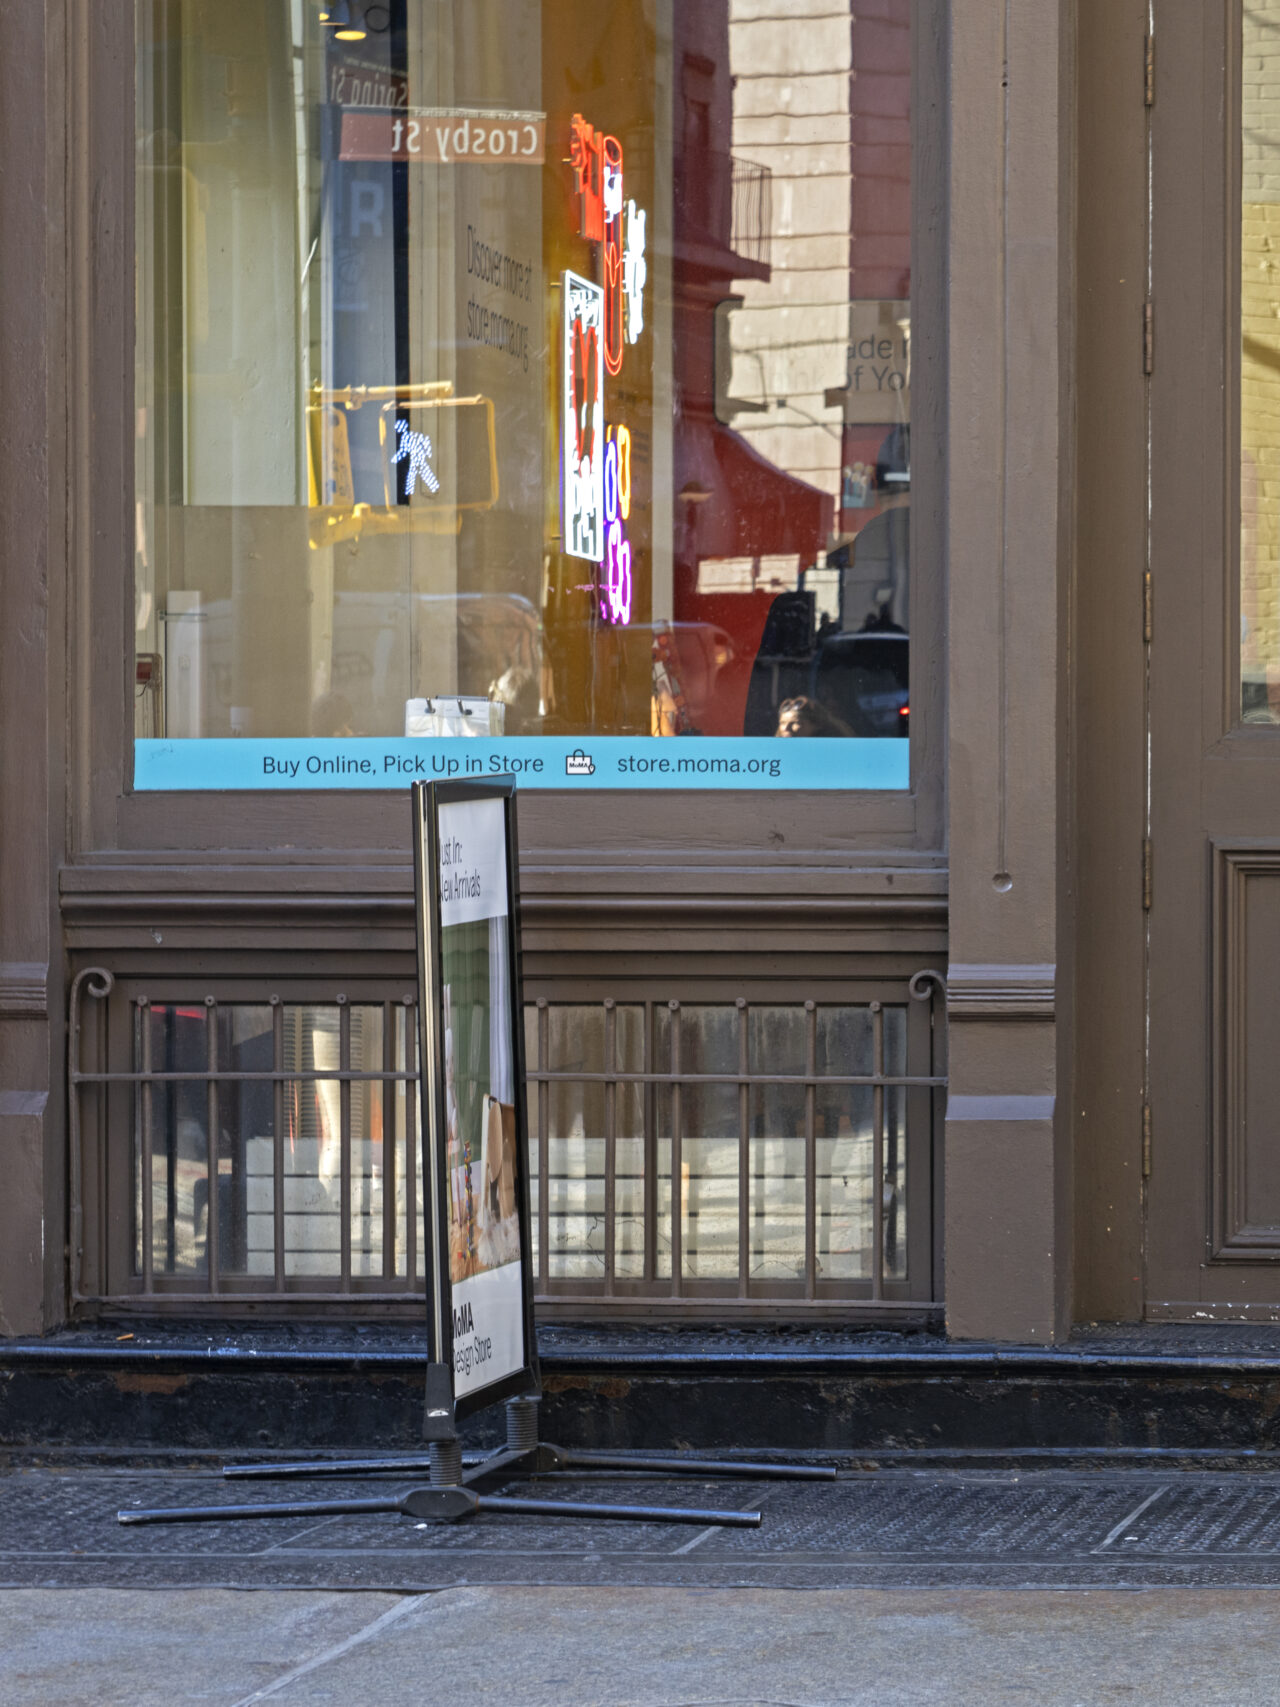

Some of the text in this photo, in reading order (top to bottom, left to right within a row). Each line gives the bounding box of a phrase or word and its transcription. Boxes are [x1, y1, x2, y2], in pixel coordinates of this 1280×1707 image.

[467, 224, 503, 289] Discover
[467, 293, 529, 374] store.moma.org
[871, 366, 911, 392] Yo
[263, 755, 544, 778] Buy Online, Pick Up in Store
[617, 755, 781, 777] store.moma.org
[454, 867, 481, 900] Arrivals
[474, 1336, 492, 1365] Store
